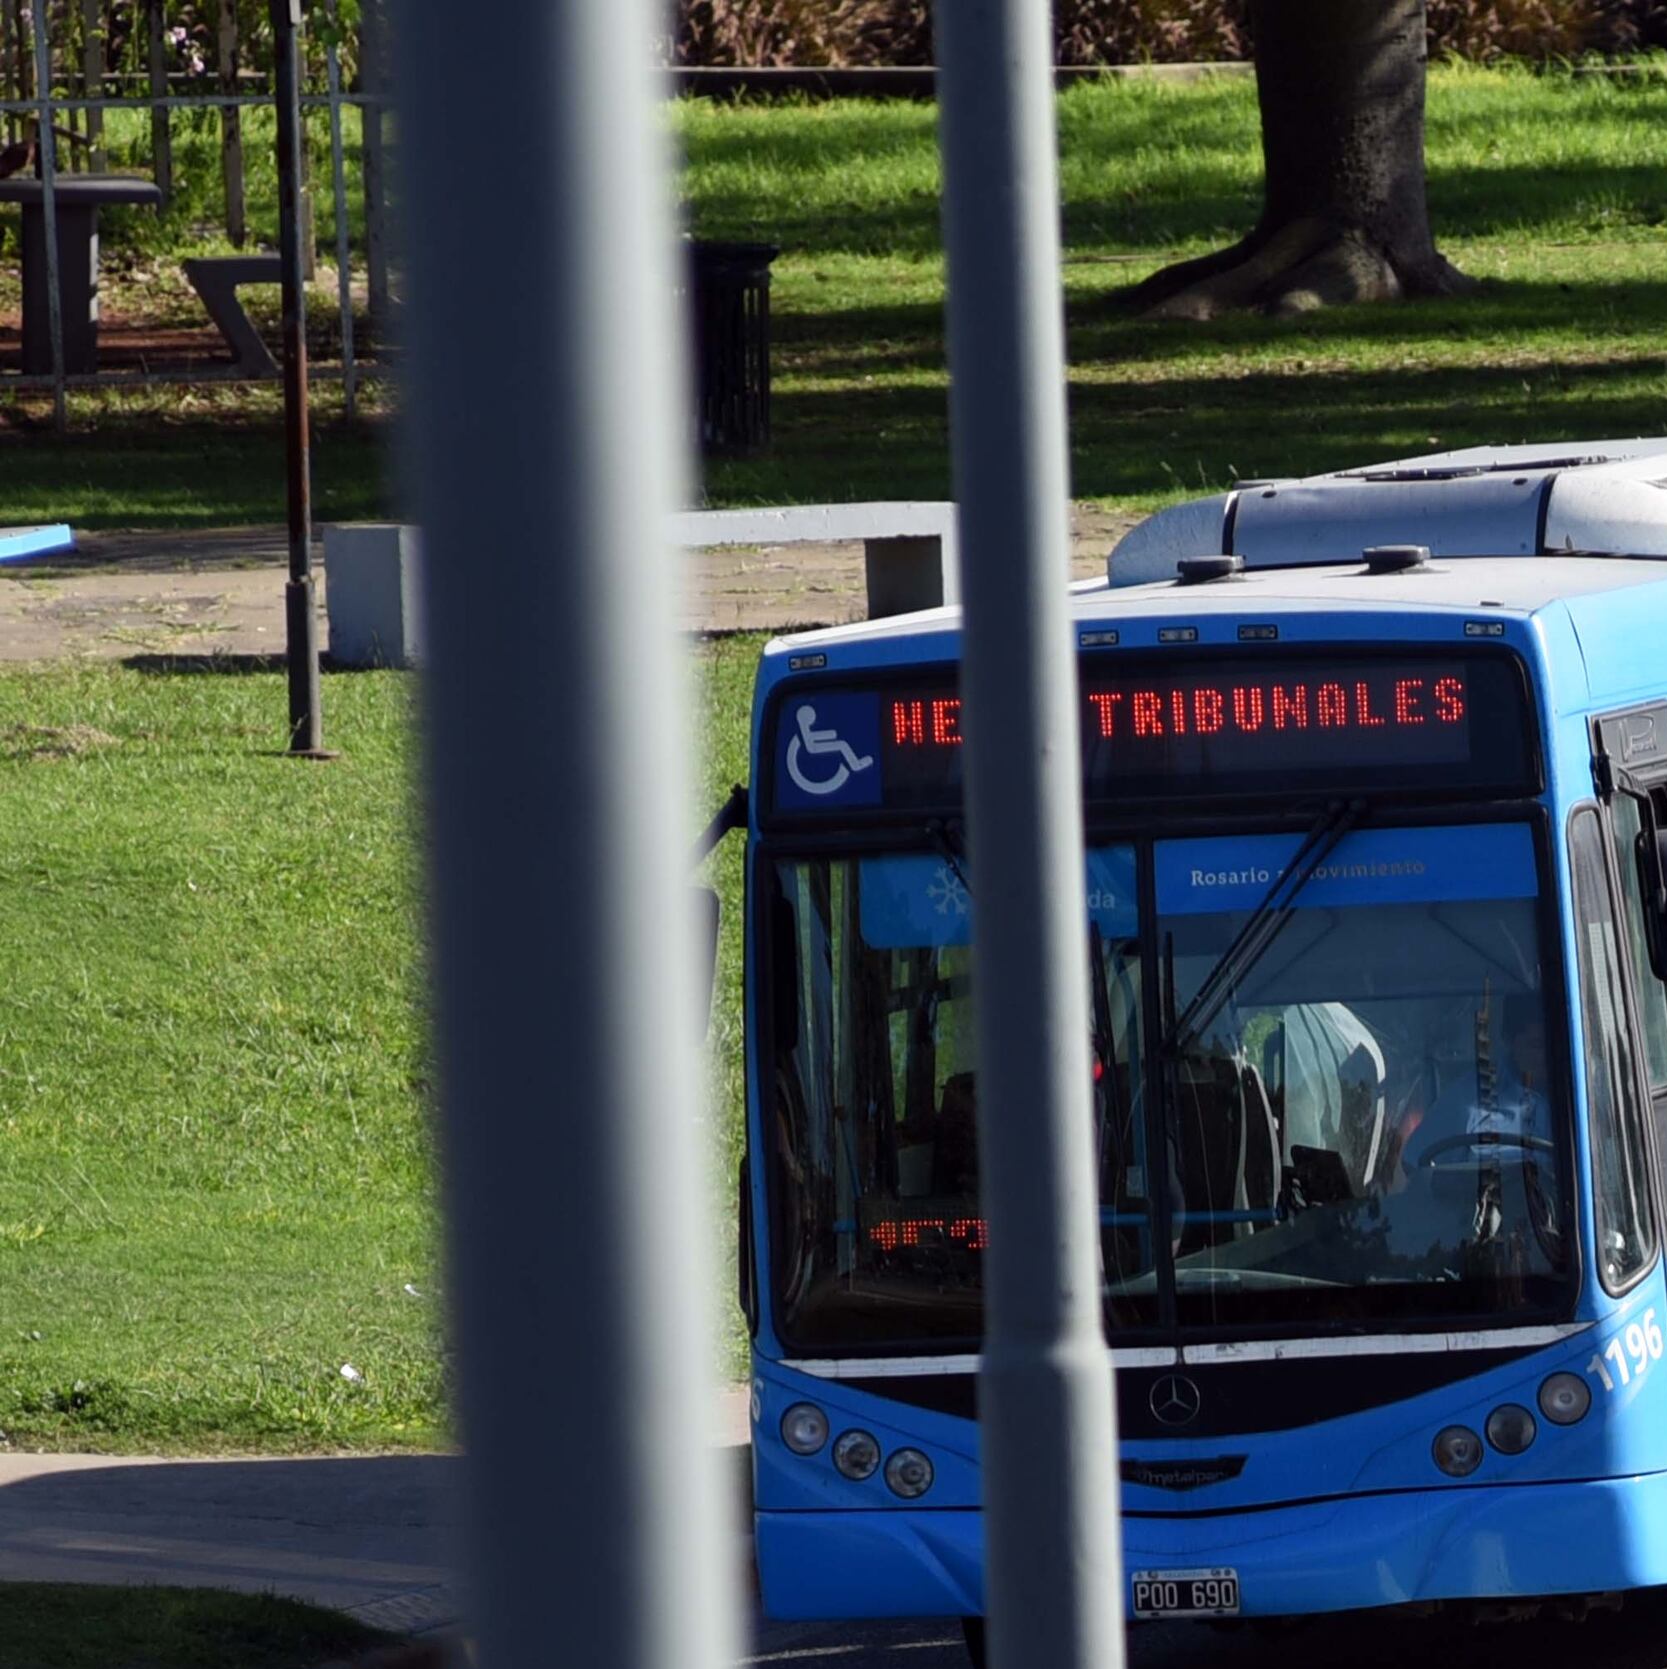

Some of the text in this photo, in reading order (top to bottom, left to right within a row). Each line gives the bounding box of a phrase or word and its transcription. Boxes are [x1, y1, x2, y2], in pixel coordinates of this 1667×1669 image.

[1089, 677, 1465, 738] TRIBUNALES
[1191, 866, 1270, 886] Rosario
[1586, 1307, 1664, 1392] 1196
[1191, 1580, 1235, 1608] 690
